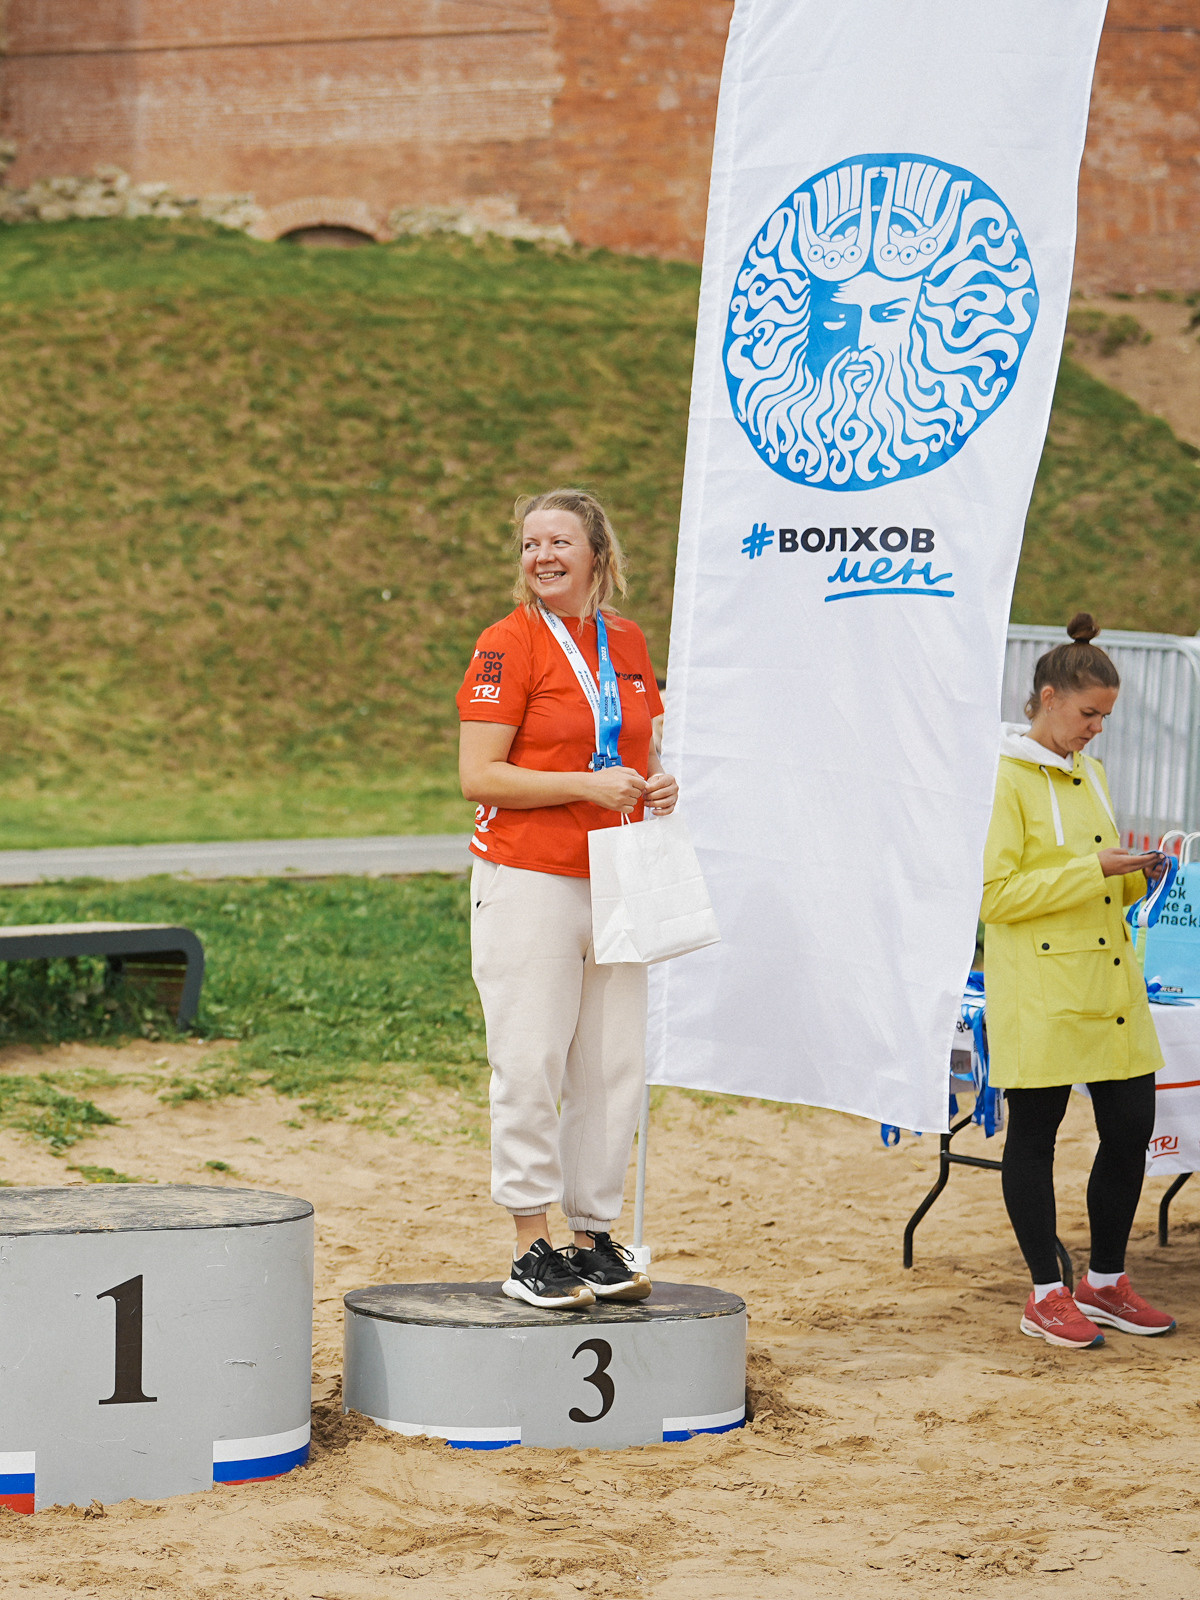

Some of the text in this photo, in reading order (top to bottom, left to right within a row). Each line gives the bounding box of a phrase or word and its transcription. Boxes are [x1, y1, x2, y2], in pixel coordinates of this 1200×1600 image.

[741, 522, 935, 560] #ВОЛХОВ
[827, 557, 953, 585] мен
[476, 671, 502, 684] rod
[483, 661, 503, 673] go
[472, 684, 501, 699] TRI
[1183, 903, 1192, 913] a
[96, 1274, 158, 1405] 1
[568, 1338, 615, 1423] 3
